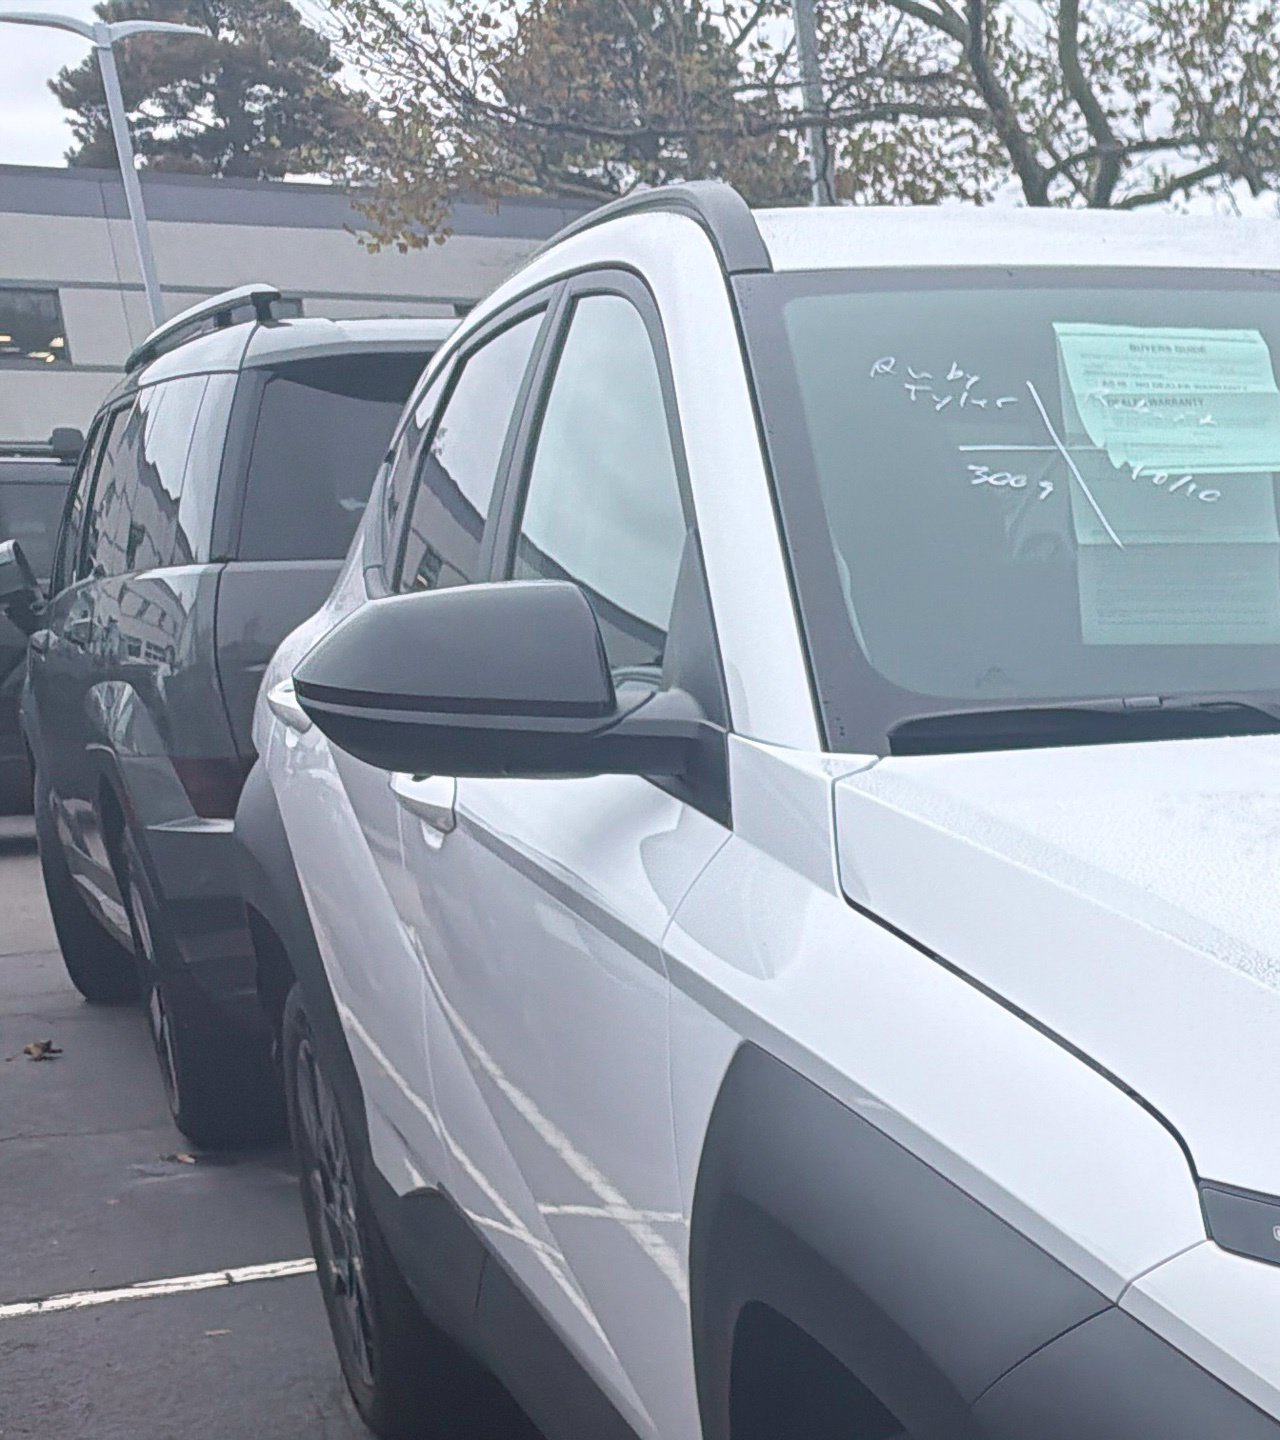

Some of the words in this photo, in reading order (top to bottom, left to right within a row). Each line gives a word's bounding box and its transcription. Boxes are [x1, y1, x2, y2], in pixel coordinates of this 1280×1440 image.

[1129, 343, 1173, 354] BUYERS
[1175, 344, 1206, 354] GUIDE
[1148, 397, 1204, 408] WARRANTY
